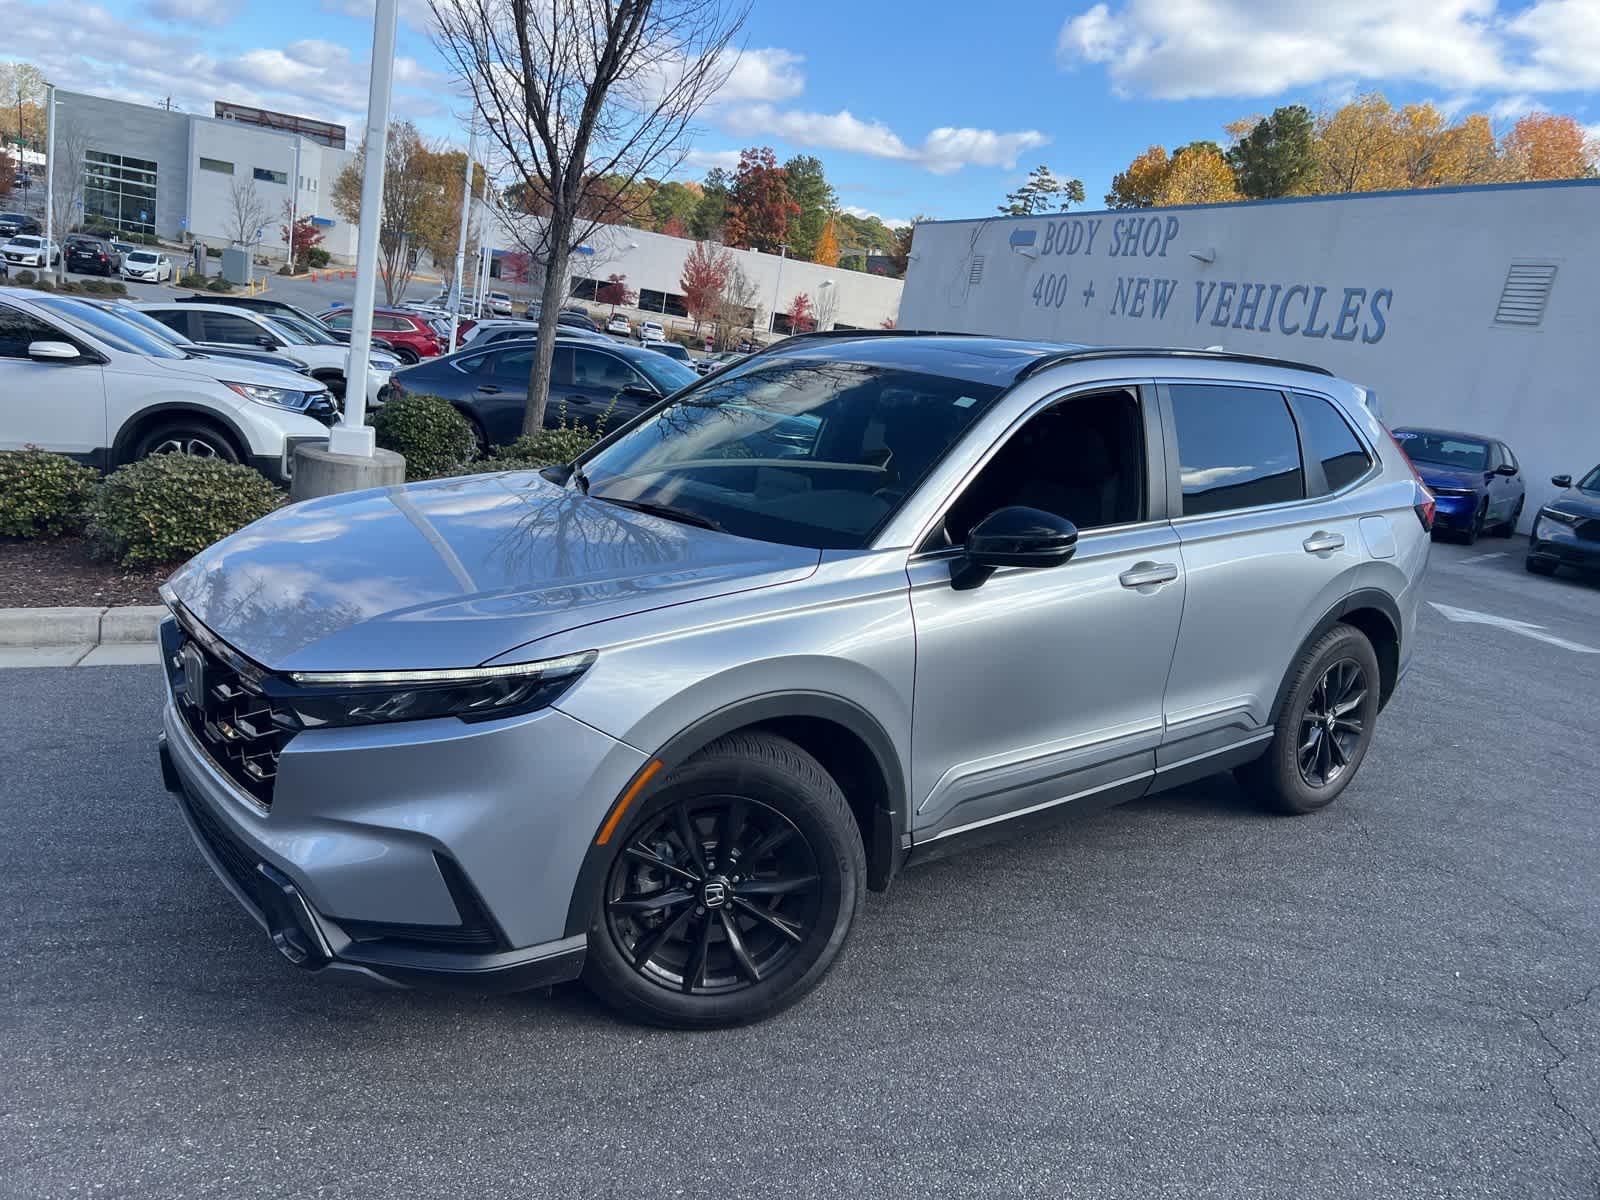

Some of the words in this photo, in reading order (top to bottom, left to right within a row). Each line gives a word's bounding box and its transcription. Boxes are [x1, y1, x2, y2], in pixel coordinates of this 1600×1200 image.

[1041, 219, 1102, 256] BODY
[1109, 216, 1179, 257] SHOP
[1032, 272, 1068, 309] 400
[1110, 276, 1178, 320] NEW
[1195, 280, 1393, 345] VEHICLES
